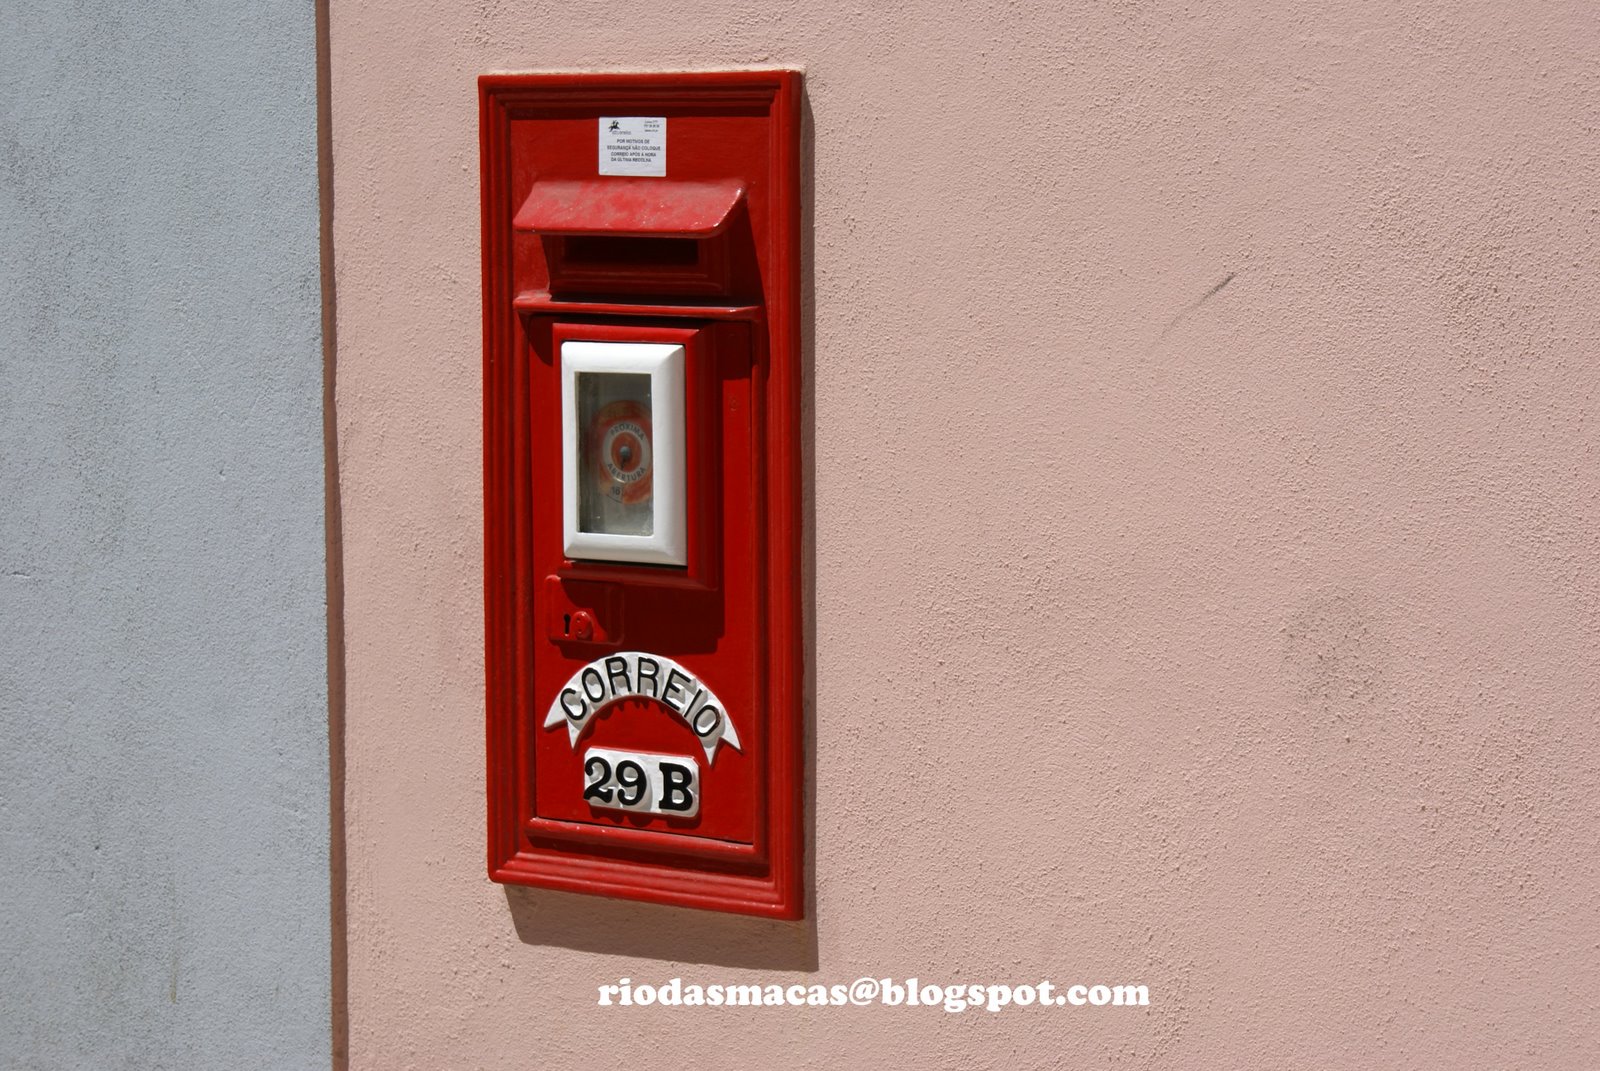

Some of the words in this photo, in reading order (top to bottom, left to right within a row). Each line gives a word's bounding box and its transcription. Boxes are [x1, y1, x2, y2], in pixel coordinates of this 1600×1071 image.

[608, 463, 646, 481] ABERTURA
[560, 656, 721, 737] CORREIO
[583, 756, 647, 806] 29
[659, 762, 693, 811] B
